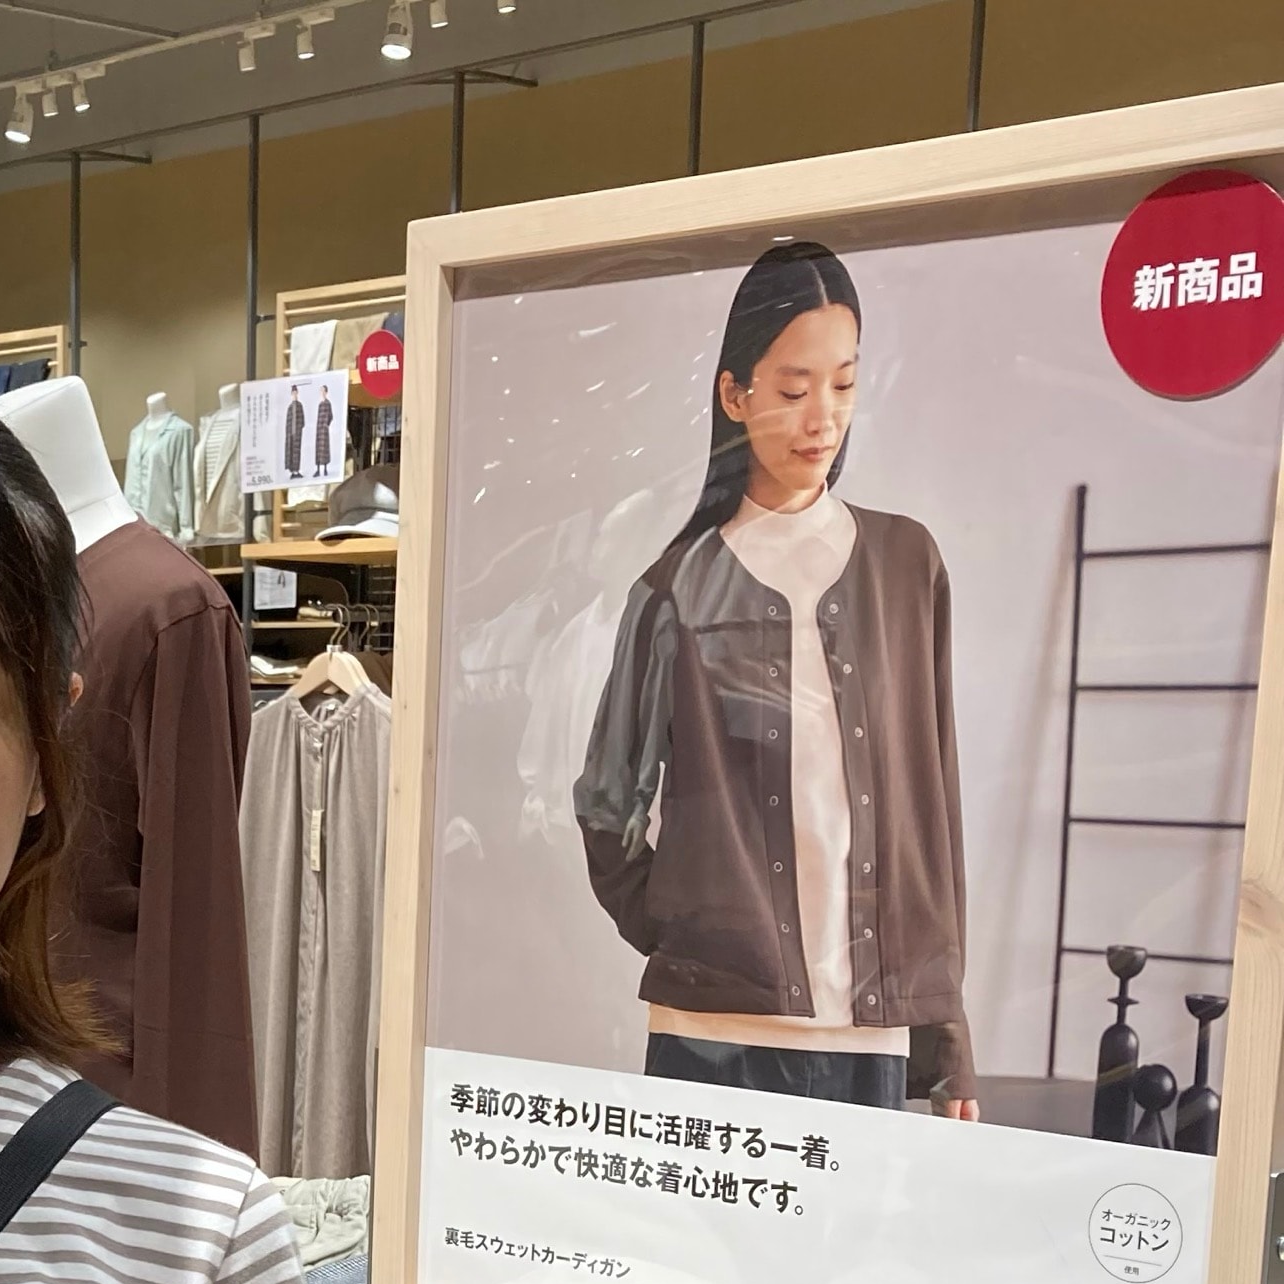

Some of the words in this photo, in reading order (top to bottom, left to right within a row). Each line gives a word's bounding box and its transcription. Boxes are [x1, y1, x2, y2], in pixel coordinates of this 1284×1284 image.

[1132, 251, 1264, 312] 新商品
[366, 354, 399, 372] 新商品
[450, 1083, 841, 1171] 季節の変わり目に活躍する一着。
[449, 1127, 805, 1216] やわらかで快適な着心地です。
[1100, 1226, 1169, 1251] コットン
[1102, 1208, 1171, 1231] オーガニック
[444, 1226, 631, 1279] 裏毛スウェットカーディガン
